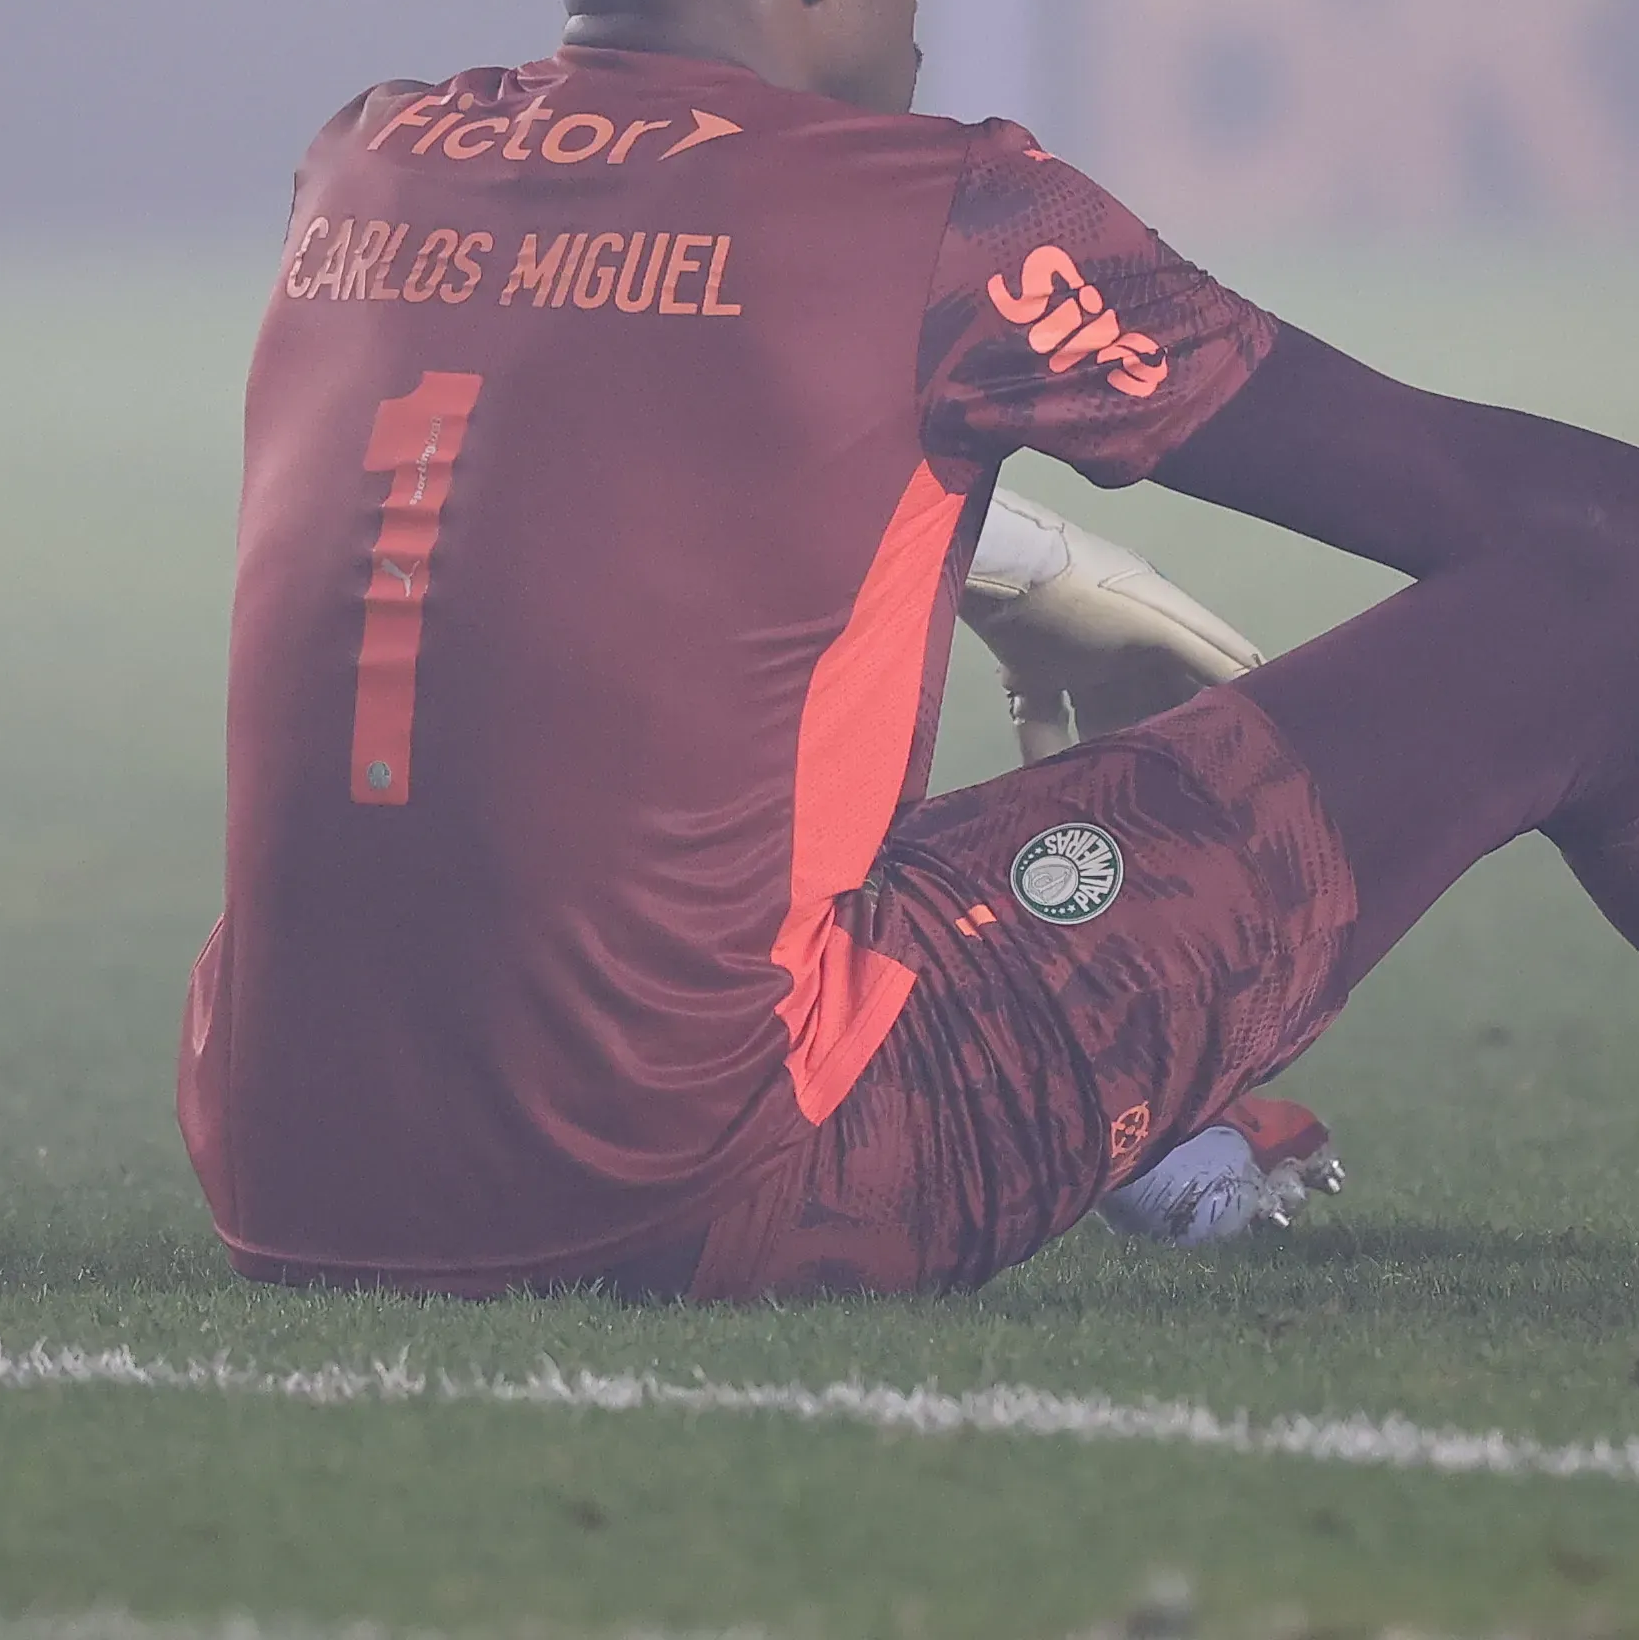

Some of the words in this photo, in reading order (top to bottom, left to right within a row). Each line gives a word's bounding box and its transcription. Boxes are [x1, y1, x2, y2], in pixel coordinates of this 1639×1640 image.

[367, 93, 672, 165] Fictor
[285, 215, 494, 304] CARLOS
[497, 231, 743, 317] MIGUEL
[350, 370, 484, 805] 1
[1043, 829, 1115, 913] PALMEIRAS
